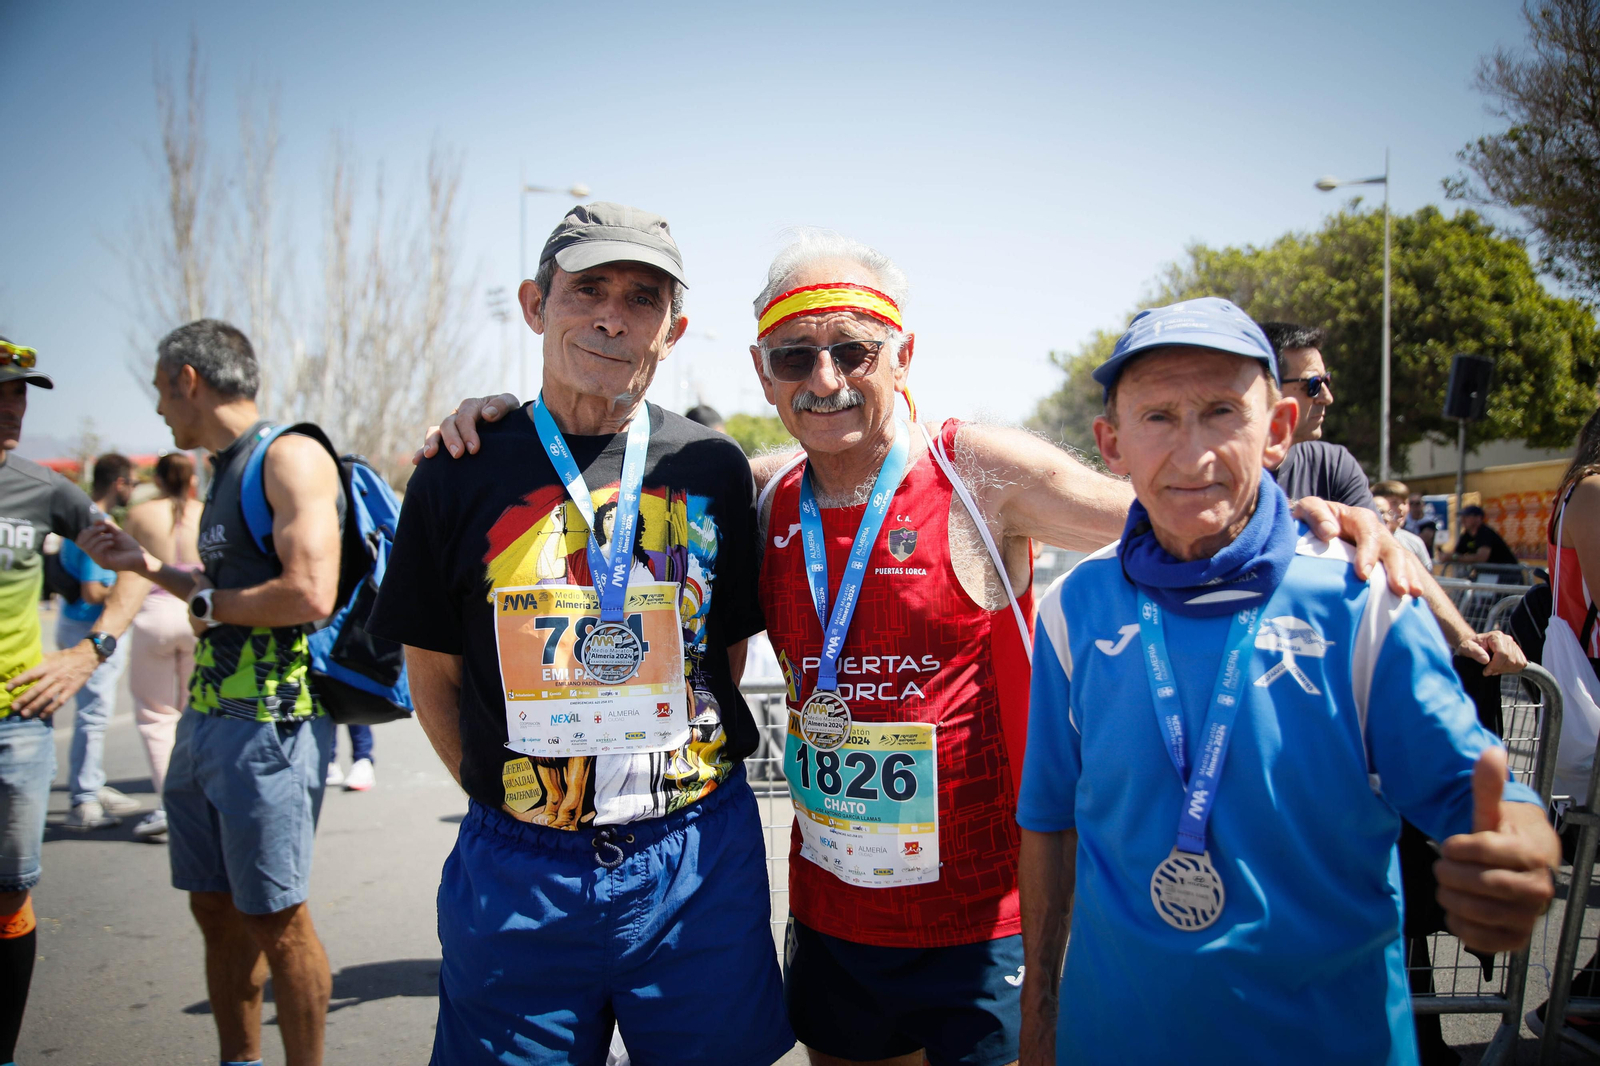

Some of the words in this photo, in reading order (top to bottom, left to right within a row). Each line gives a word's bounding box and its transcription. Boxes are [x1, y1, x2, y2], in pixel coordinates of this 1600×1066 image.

[625, 513, 634, 530] 2024
[809, 529, 817, 559] ALMERÍA
[856, 527, 870, 556] ALMERÍA
[874, 567, 904, 576] PUERTAS
[905, 567, 927, 576] LORCA
[554, 591, 581, 600] Medio
[846, 584, 857, 603] 2024
[555, 600, 591, 610] Almería
[1148, 644, 1163, 682] ALMERÍA
[1223, 650, 1239, 688] ALMERÍA
[541, 668, 570, 681] EMI
[838, 681, 926, 701] ORCA
[550, 712, 581, 726] NEXAL
[608, 709, 640, 718] ALMERÍA
[852, 728, 870, 736] atón
[1171, 713, 1182, 741] 2024
[846, 736, 871, 745] 2024
[1212, 724, 1227, 750] 2024
[795, 742, 918, 802] 1826
[824, 797, 867, 815] CHATO
[858, 845, 888, 854] ALMERÍA
